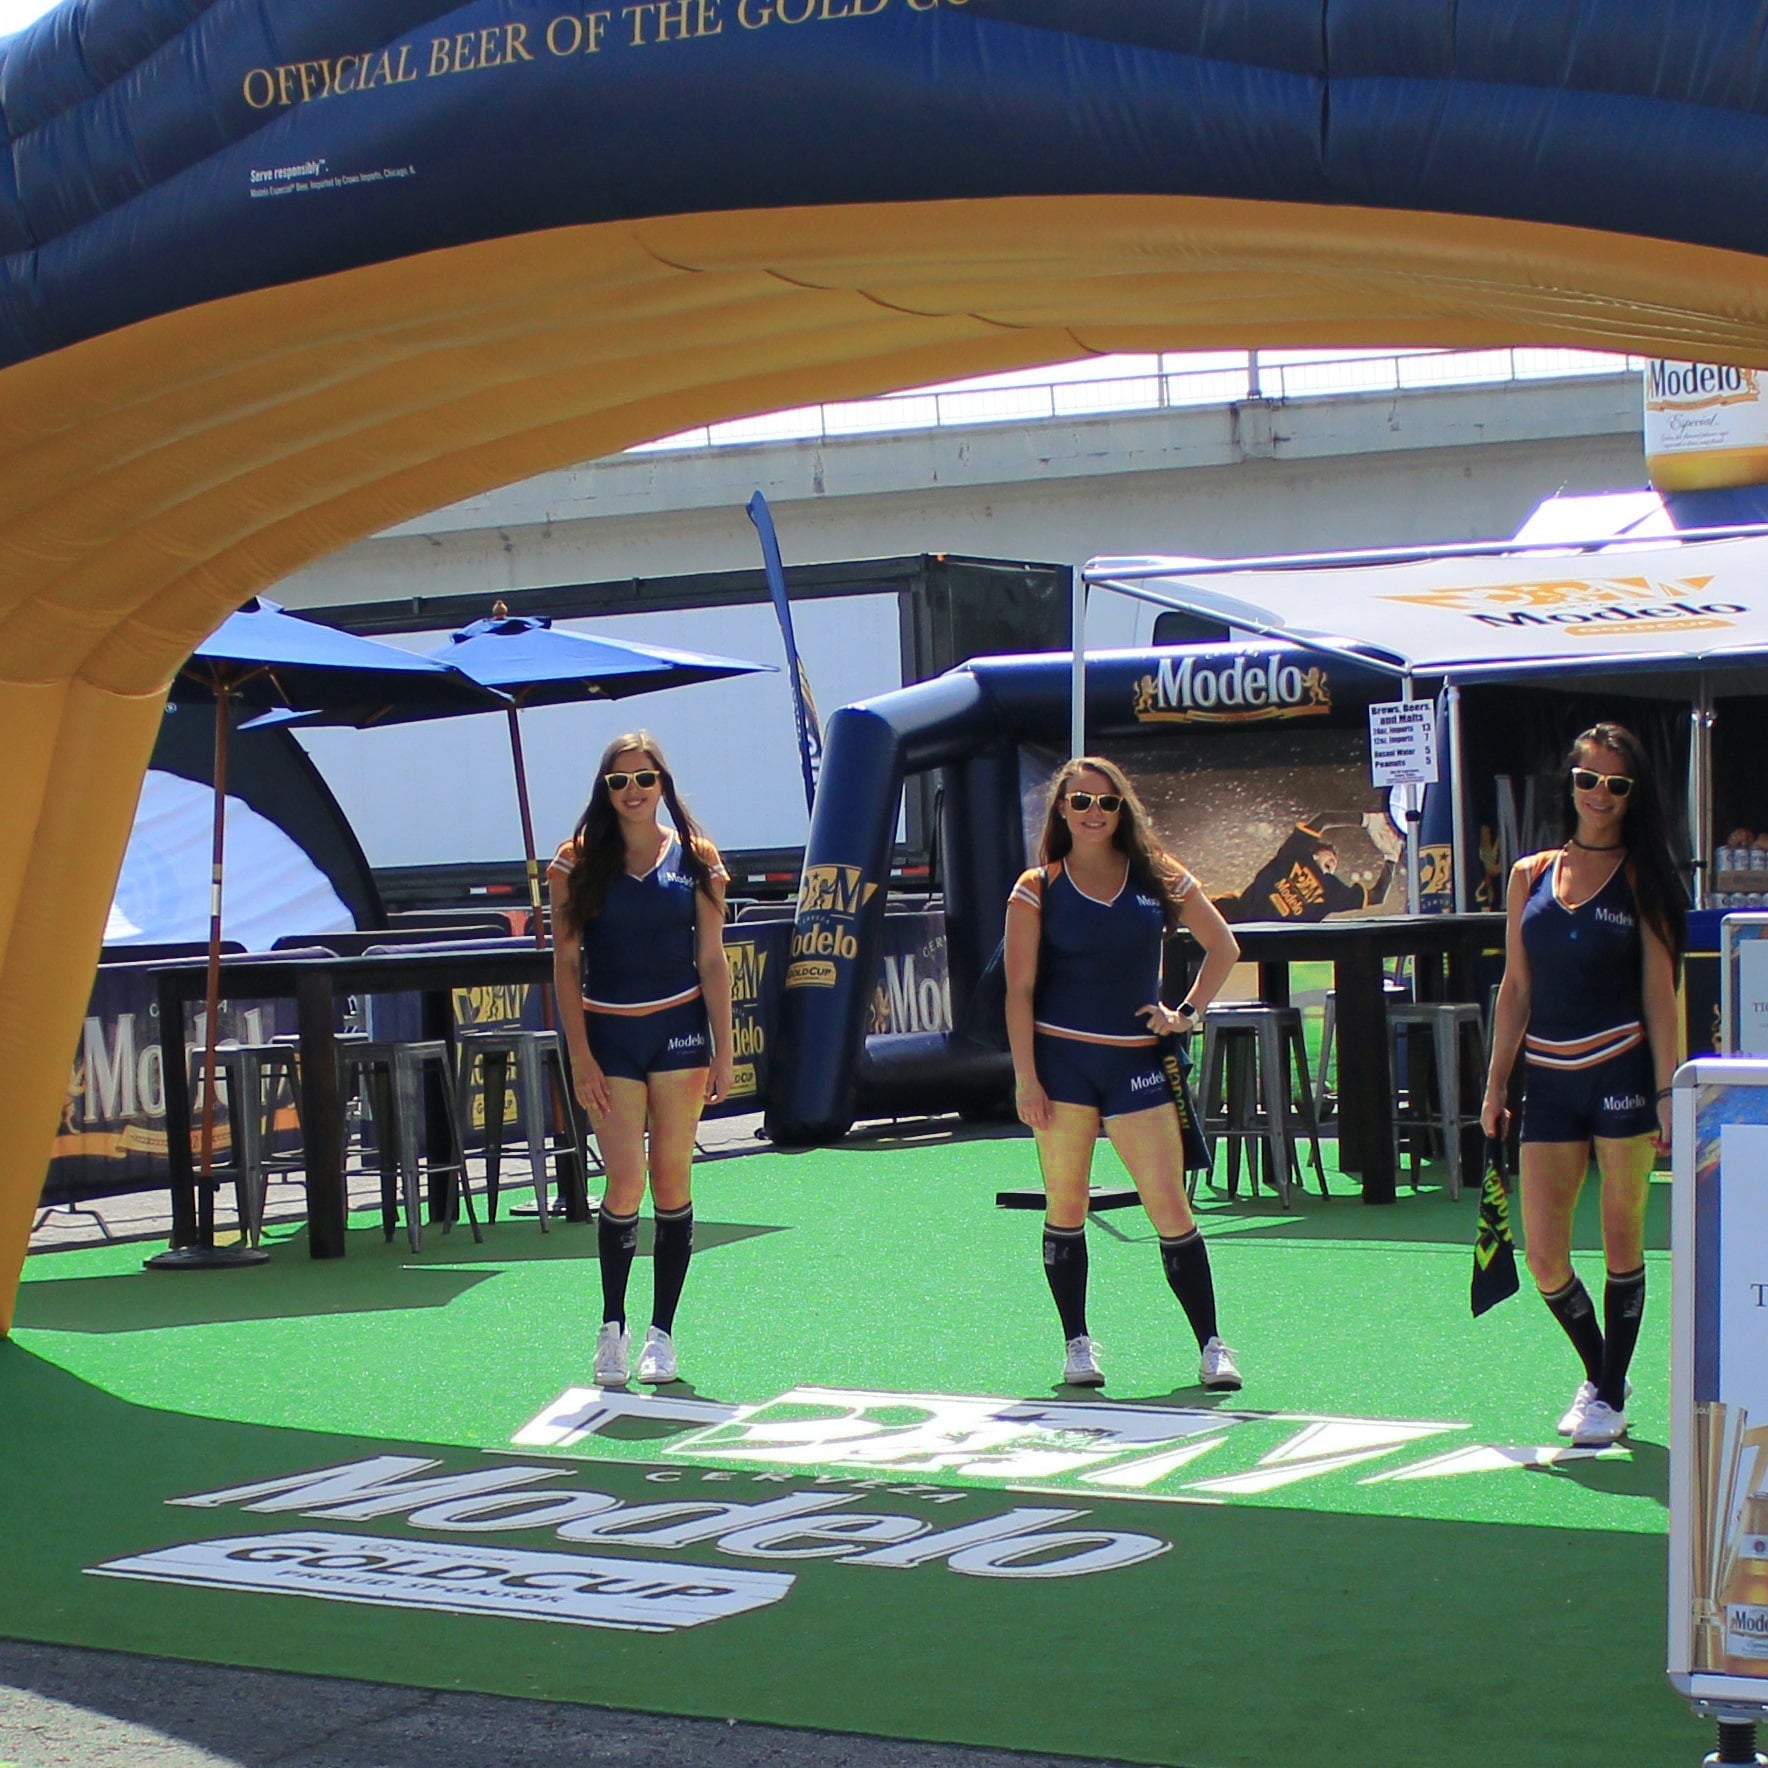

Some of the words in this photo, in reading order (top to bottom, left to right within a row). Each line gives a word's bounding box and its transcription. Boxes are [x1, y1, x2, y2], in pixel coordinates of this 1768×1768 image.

[243, 45, 417, 109] OFFICIAL
[426, 23, 534, 78] BEER
[546, 11, 611, 56] OF
[622, 0, 722, 46] THE
[250, 170, 273, 183] Serve
[1650, 358, 1741, 398] Modelo
[1467, 603, 1750, 628] Modelo
[1157, 654, 1303, 708] Modelo
[1398, 714, 1423, 723] Malts
[1422, 723, 1431, 731] 13
[1425, 733, 1429, 741] 7
[1425, 746, 1431, 754] 5
[1375, 760, 1406, 768] Peanuts
[1425, 756, 1431, 765] 5
[667, 1033, 705, 1051] Modelo
[1603, 1094, 1646, 1110] Modelo
[645, 1471, 968, 1504] CERVEZA
[163, 1454, 1175, 1578] Modelo
[276, 1567, 396, 1587] PROUD
[409, 1581, 568, 1605] SPONSOR
